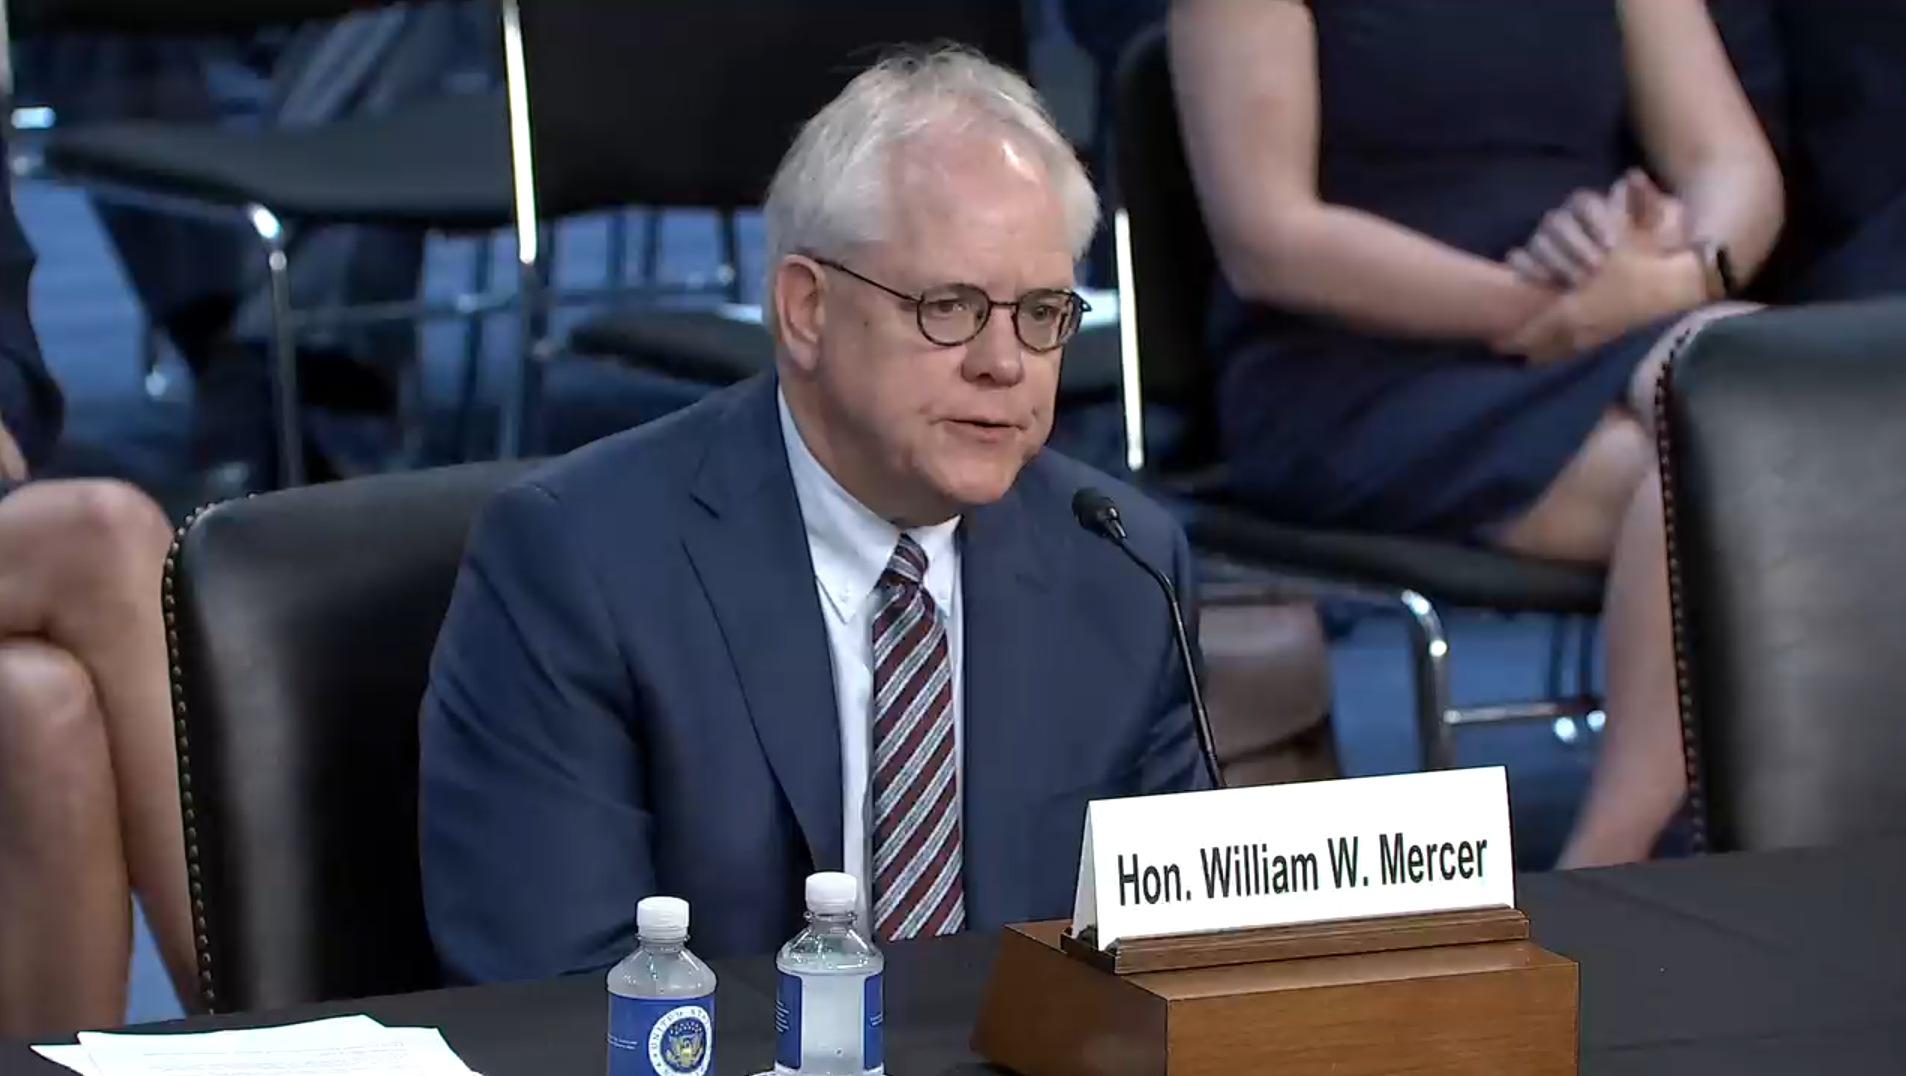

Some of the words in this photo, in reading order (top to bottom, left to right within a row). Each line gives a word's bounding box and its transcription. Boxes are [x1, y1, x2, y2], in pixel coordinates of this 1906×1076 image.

[1117, 853, 1191, 906] Hon.
[1200, 843, 1319, 899] William
[1327, 836, 1370, 889] W.
[1379, 832, 1488, 885] Mercer
